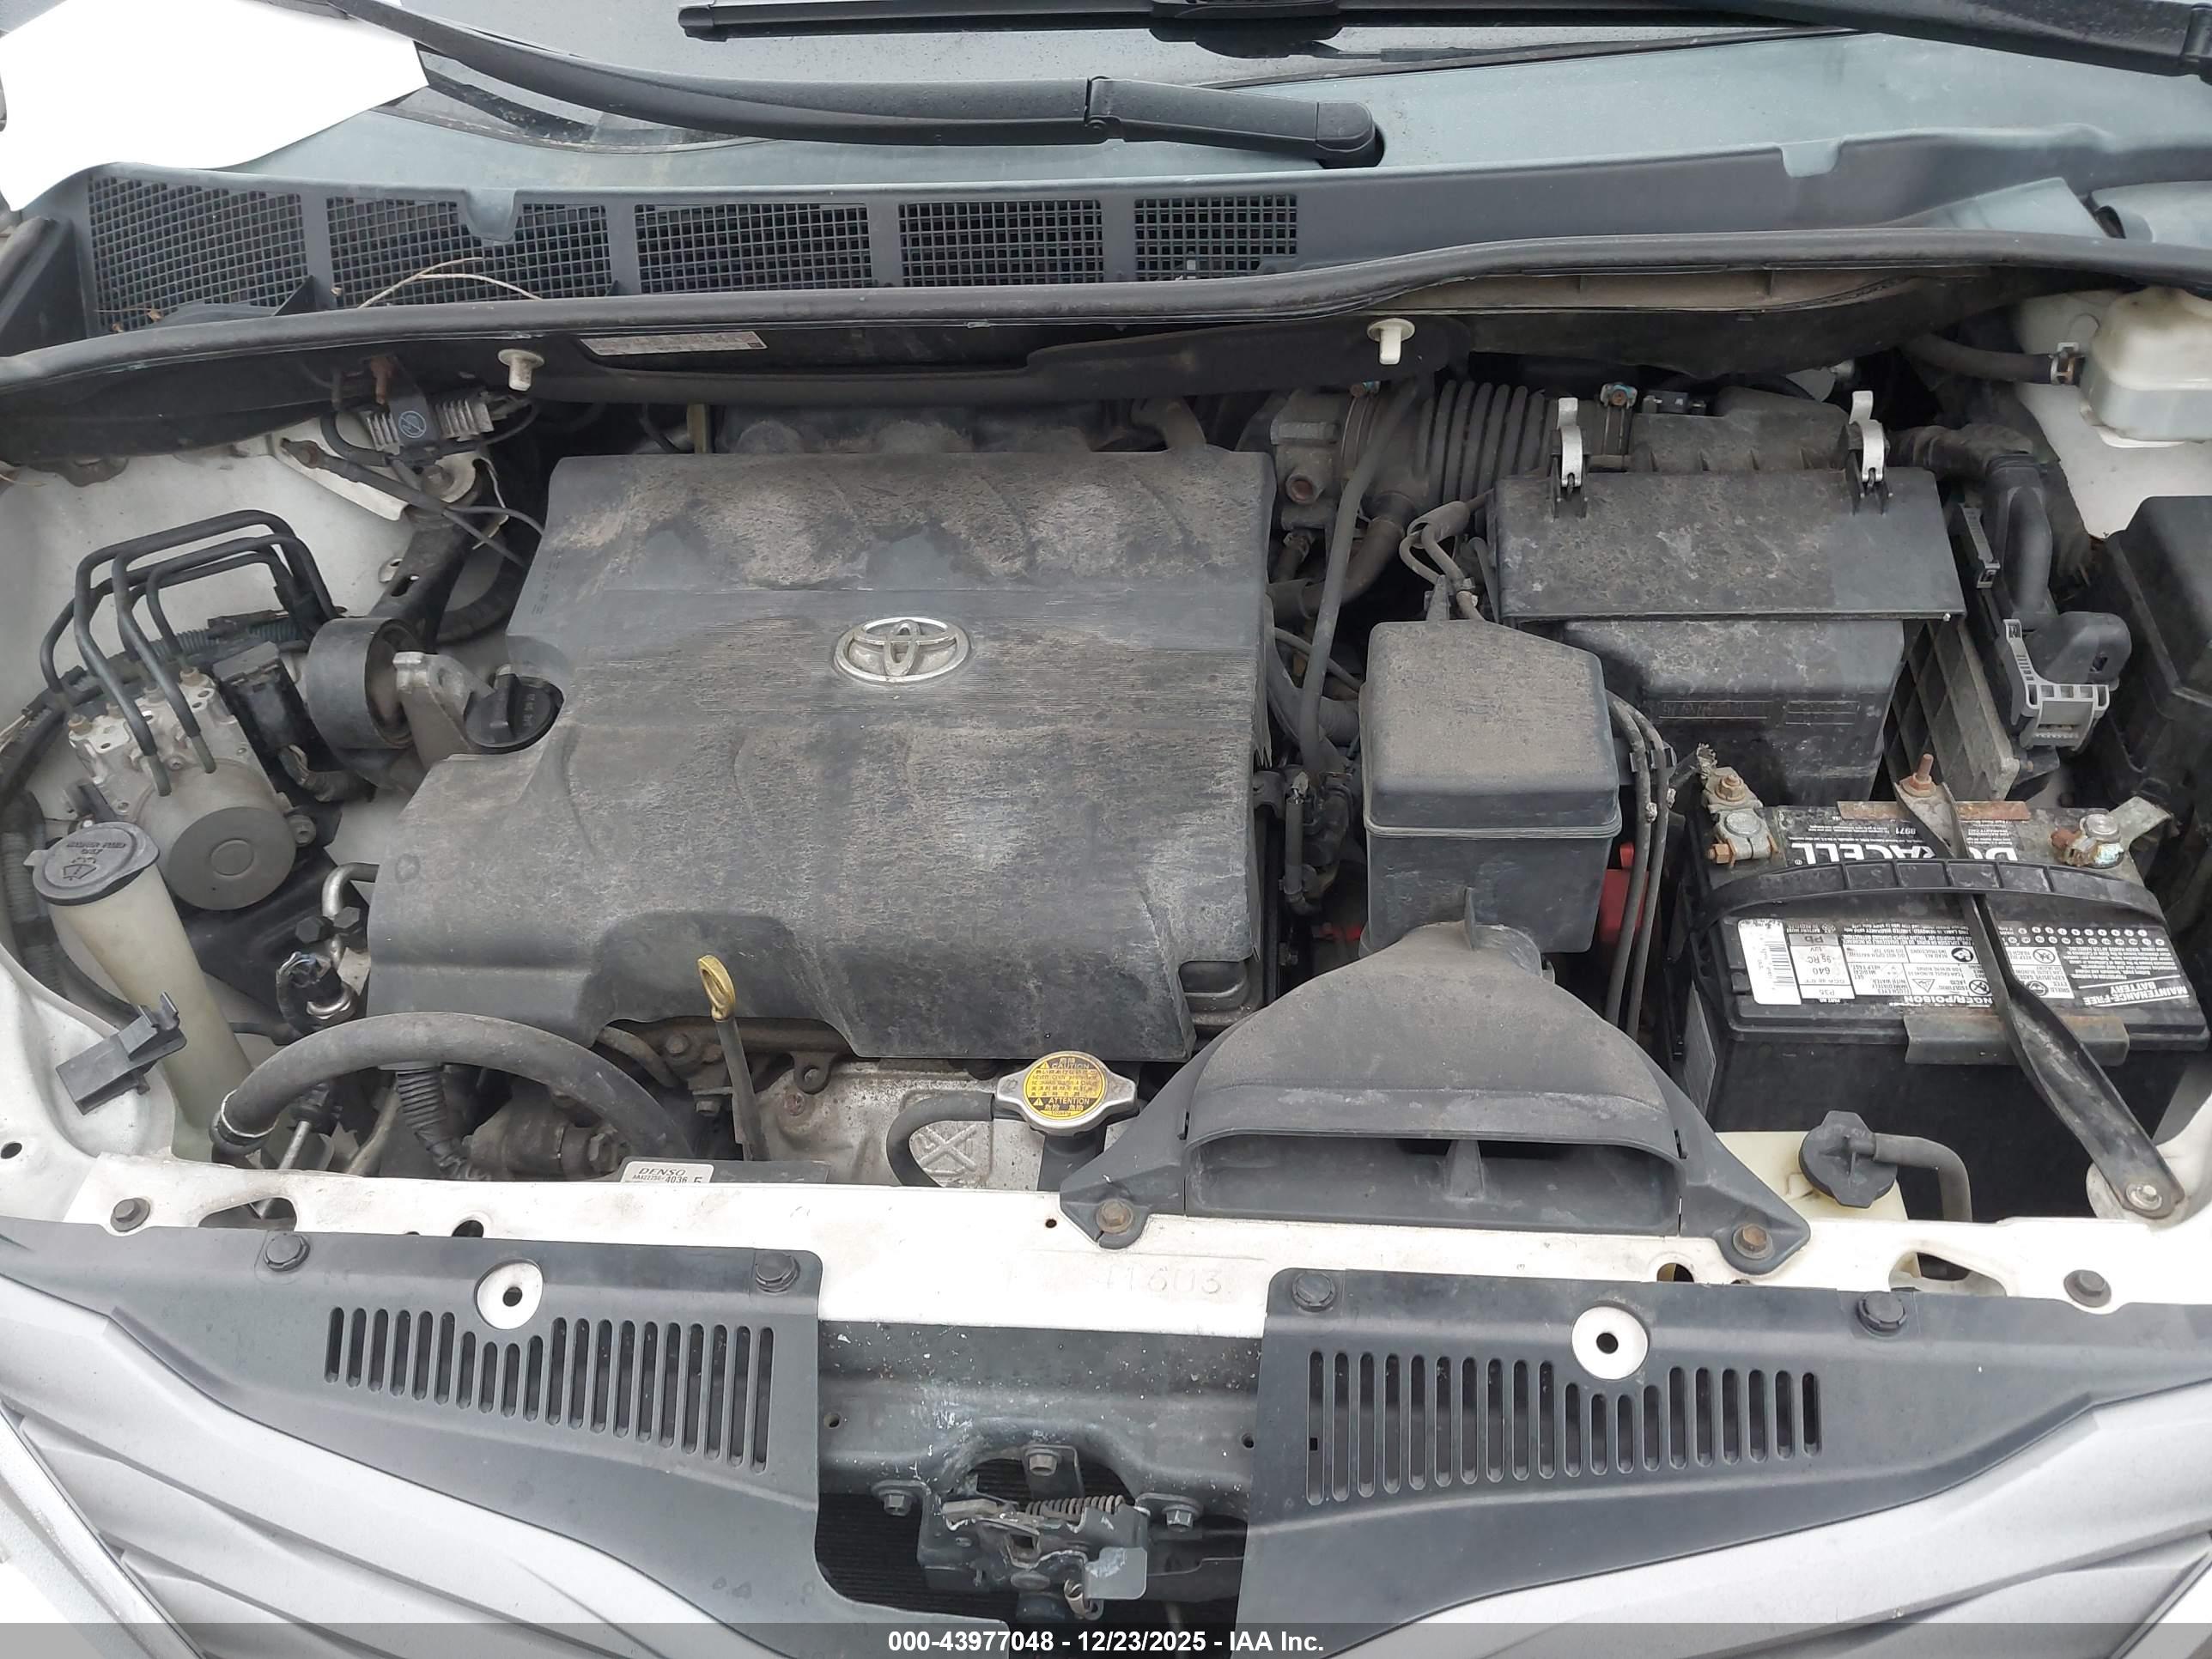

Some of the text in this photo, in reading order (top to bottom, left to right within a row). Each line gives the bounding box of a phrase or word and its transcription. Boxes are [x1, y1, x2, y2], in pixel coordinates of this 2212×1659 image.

[2110, 981, 2156, 994] BATTERY
[1903, 996, 1992, 1005] NGER/POISON
[2082, 985, 2188, 1006] MAINTENANCE-FREE
[638, 1168, 686, 1176] DENSO
